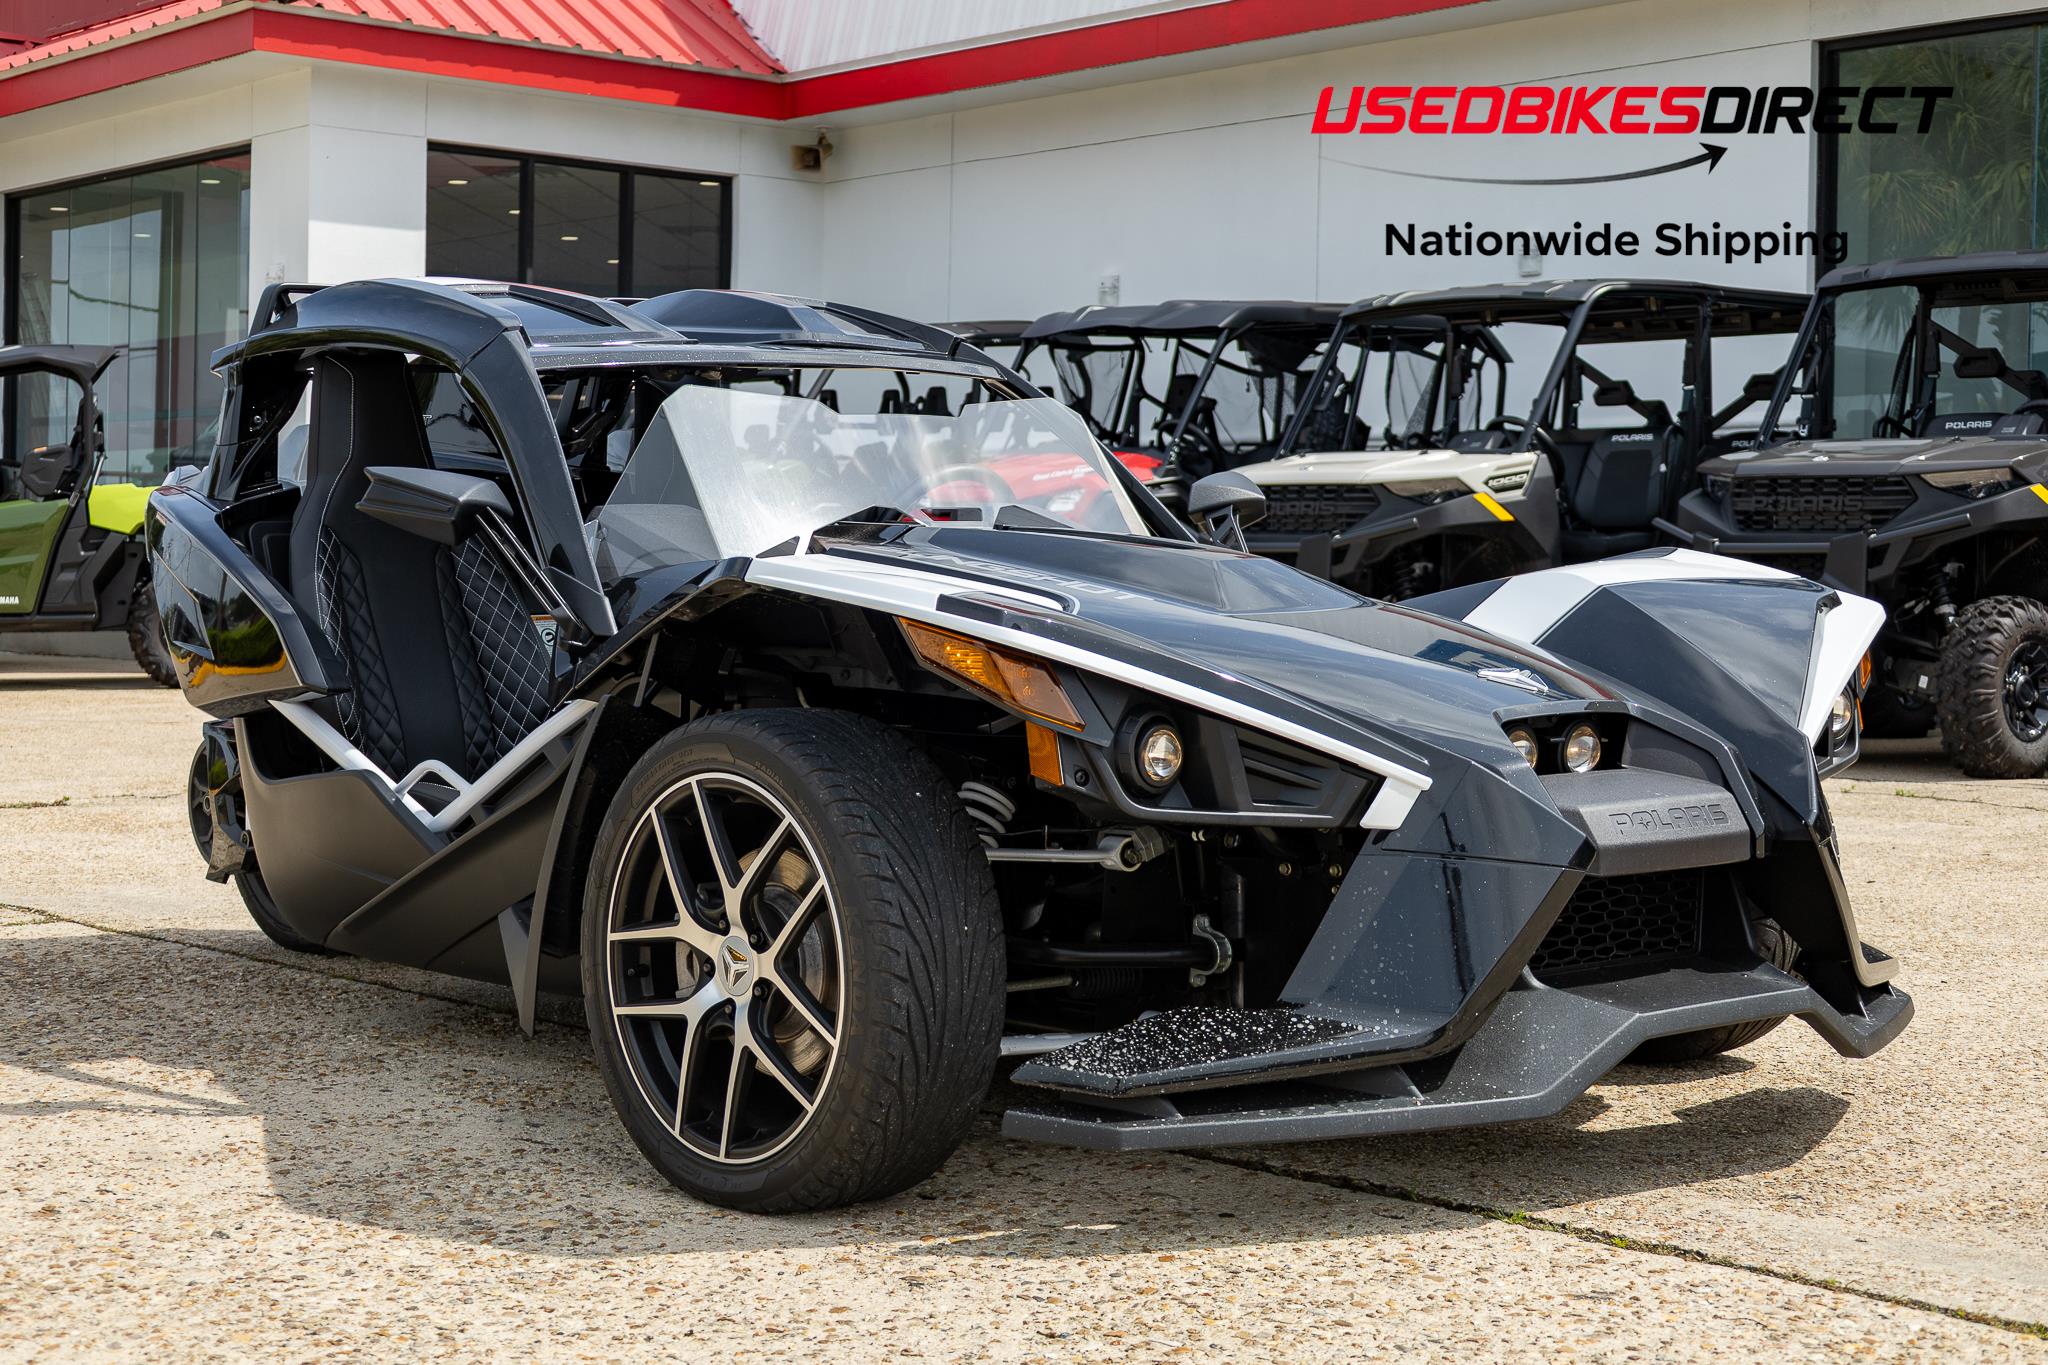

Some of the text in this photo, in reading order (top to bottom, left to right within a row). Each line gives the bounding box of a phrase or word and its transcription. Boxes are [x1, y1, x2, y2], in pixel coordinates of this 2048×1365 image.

[1945, 420, 1993, 430] POLARIS
[1611, 433, 1654, 442] POLARIS
[1488, 473, 1528, 487] 1000
[1752, 495, 1864, 512] POLARIS
[1608, 803, 1731, 835] POLARIS
